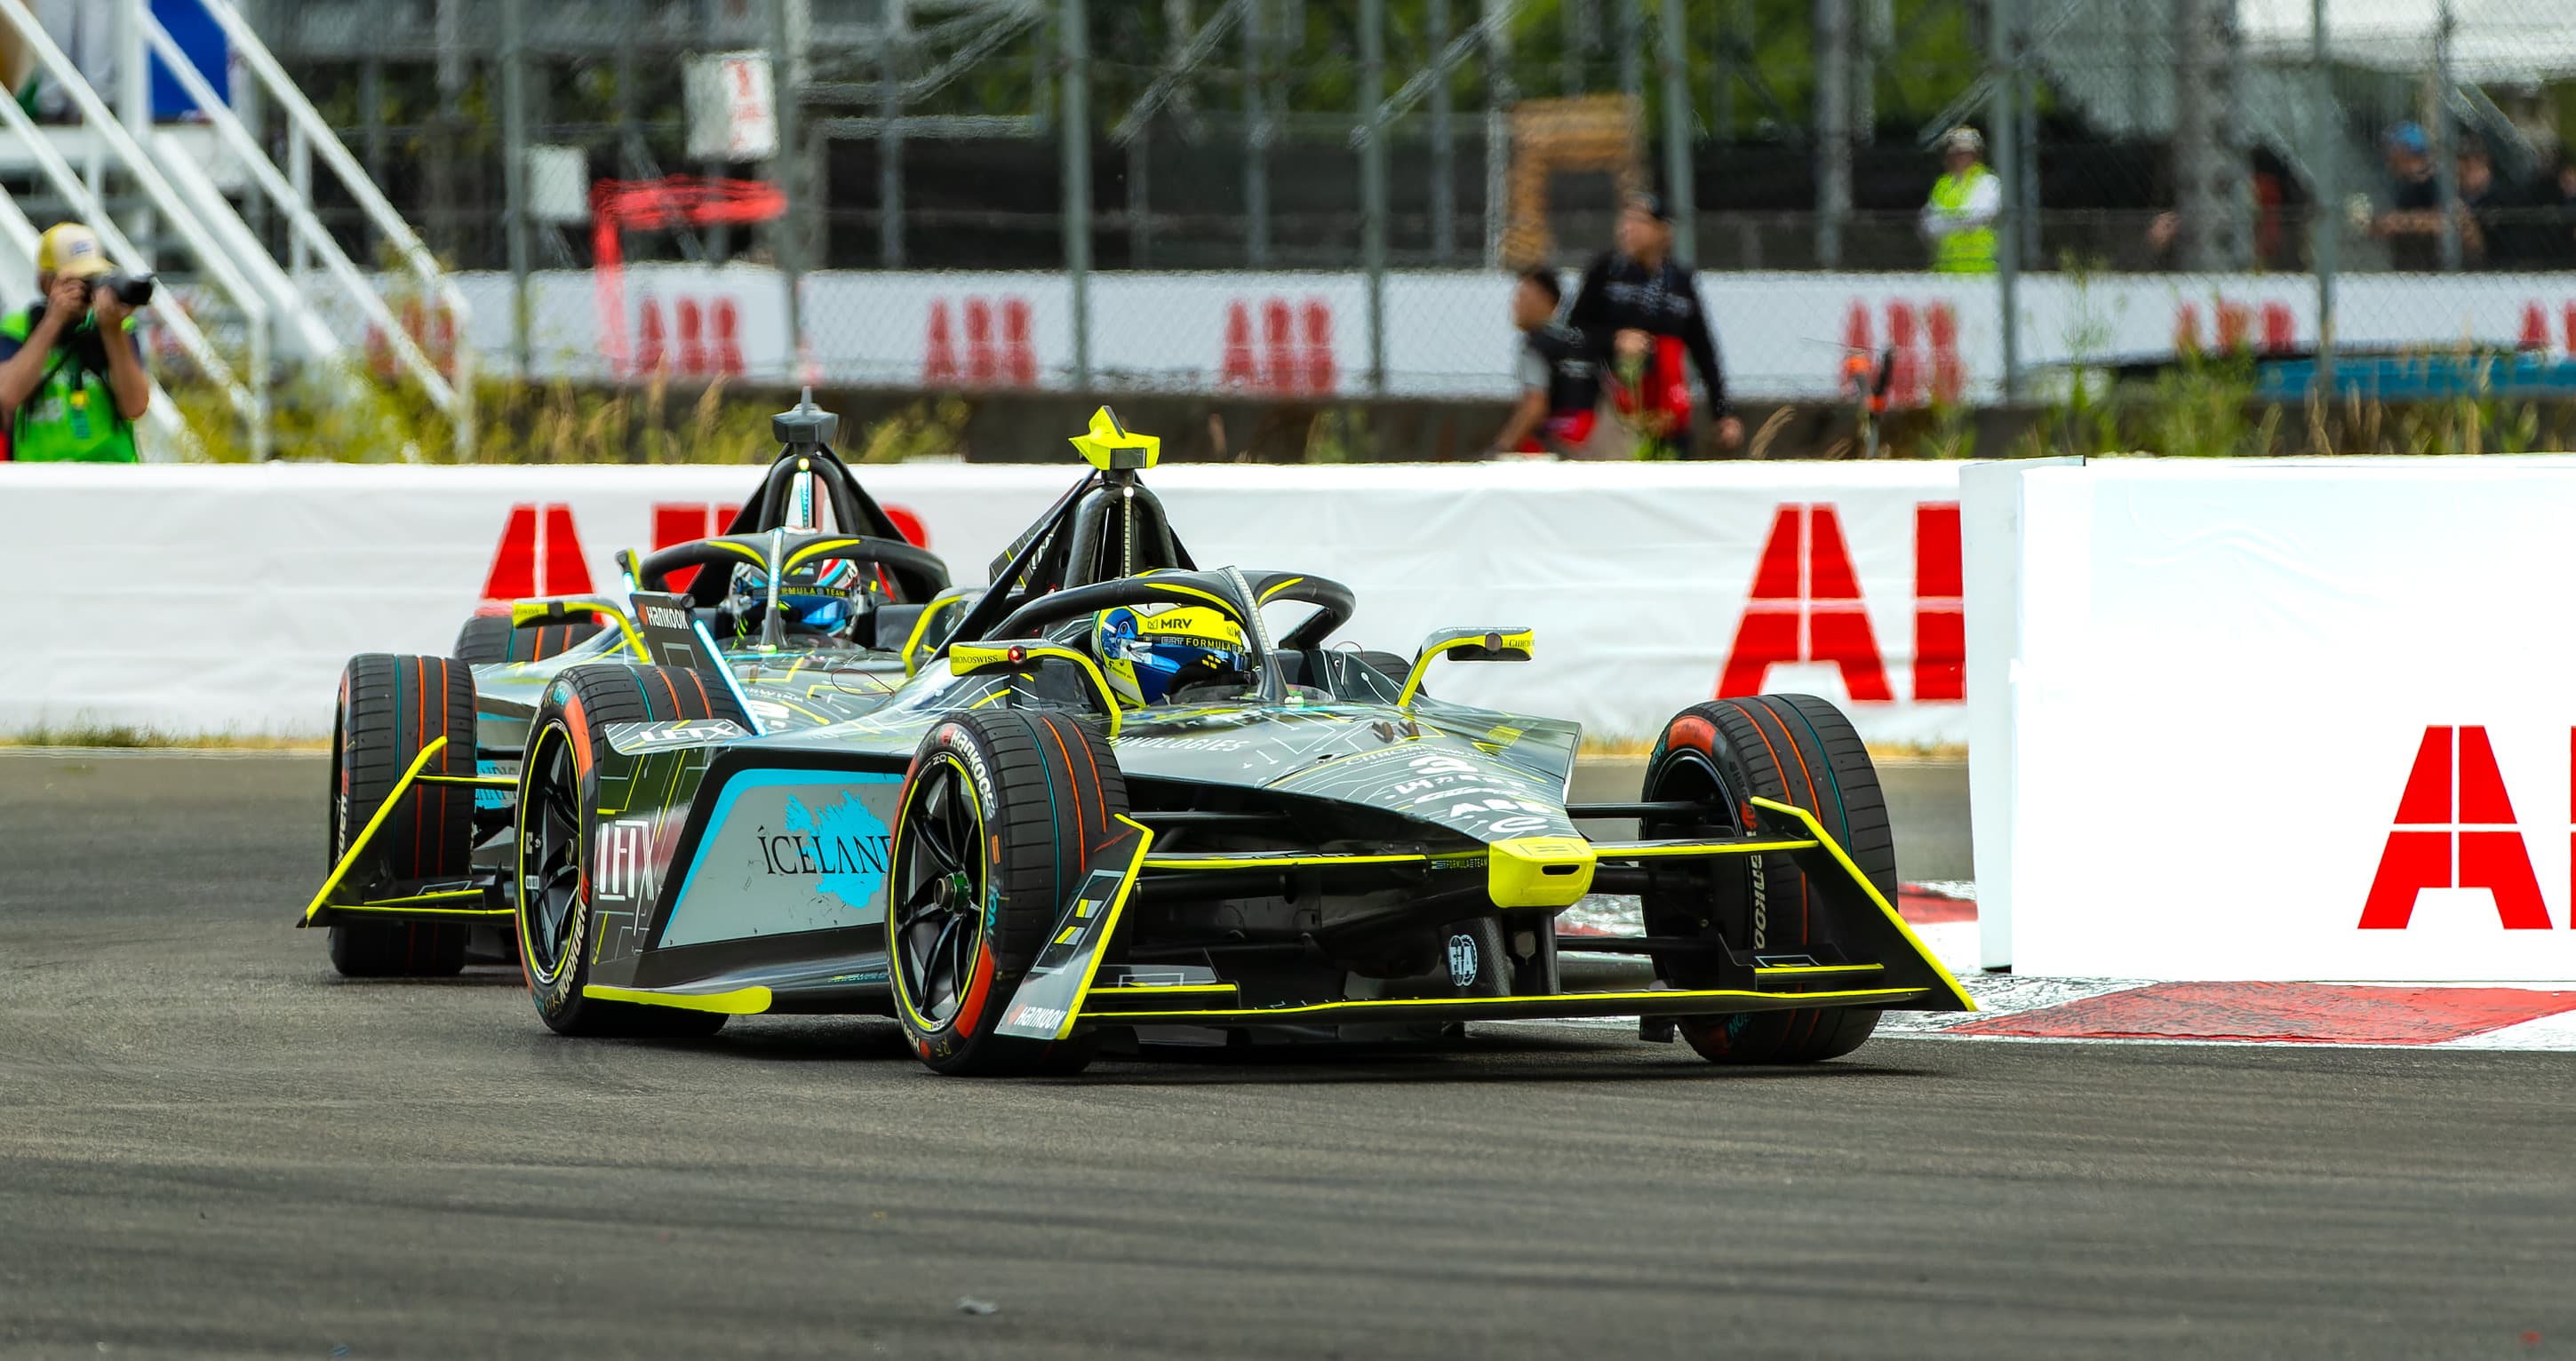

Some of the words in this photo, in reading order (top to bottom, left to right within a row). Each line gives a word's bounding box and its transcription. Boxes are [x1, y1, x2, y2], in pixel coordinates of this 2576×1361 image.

[636, 297, 746, 374] ABB
[924, 296, 1038, 386] ABB
[1222, 297, 1337, 395] ABB
[1160, 618, 1192, 630] MRV
[1185, 637, 1232, 652] FORMULA
[2357, 724, 2576, 930] A
